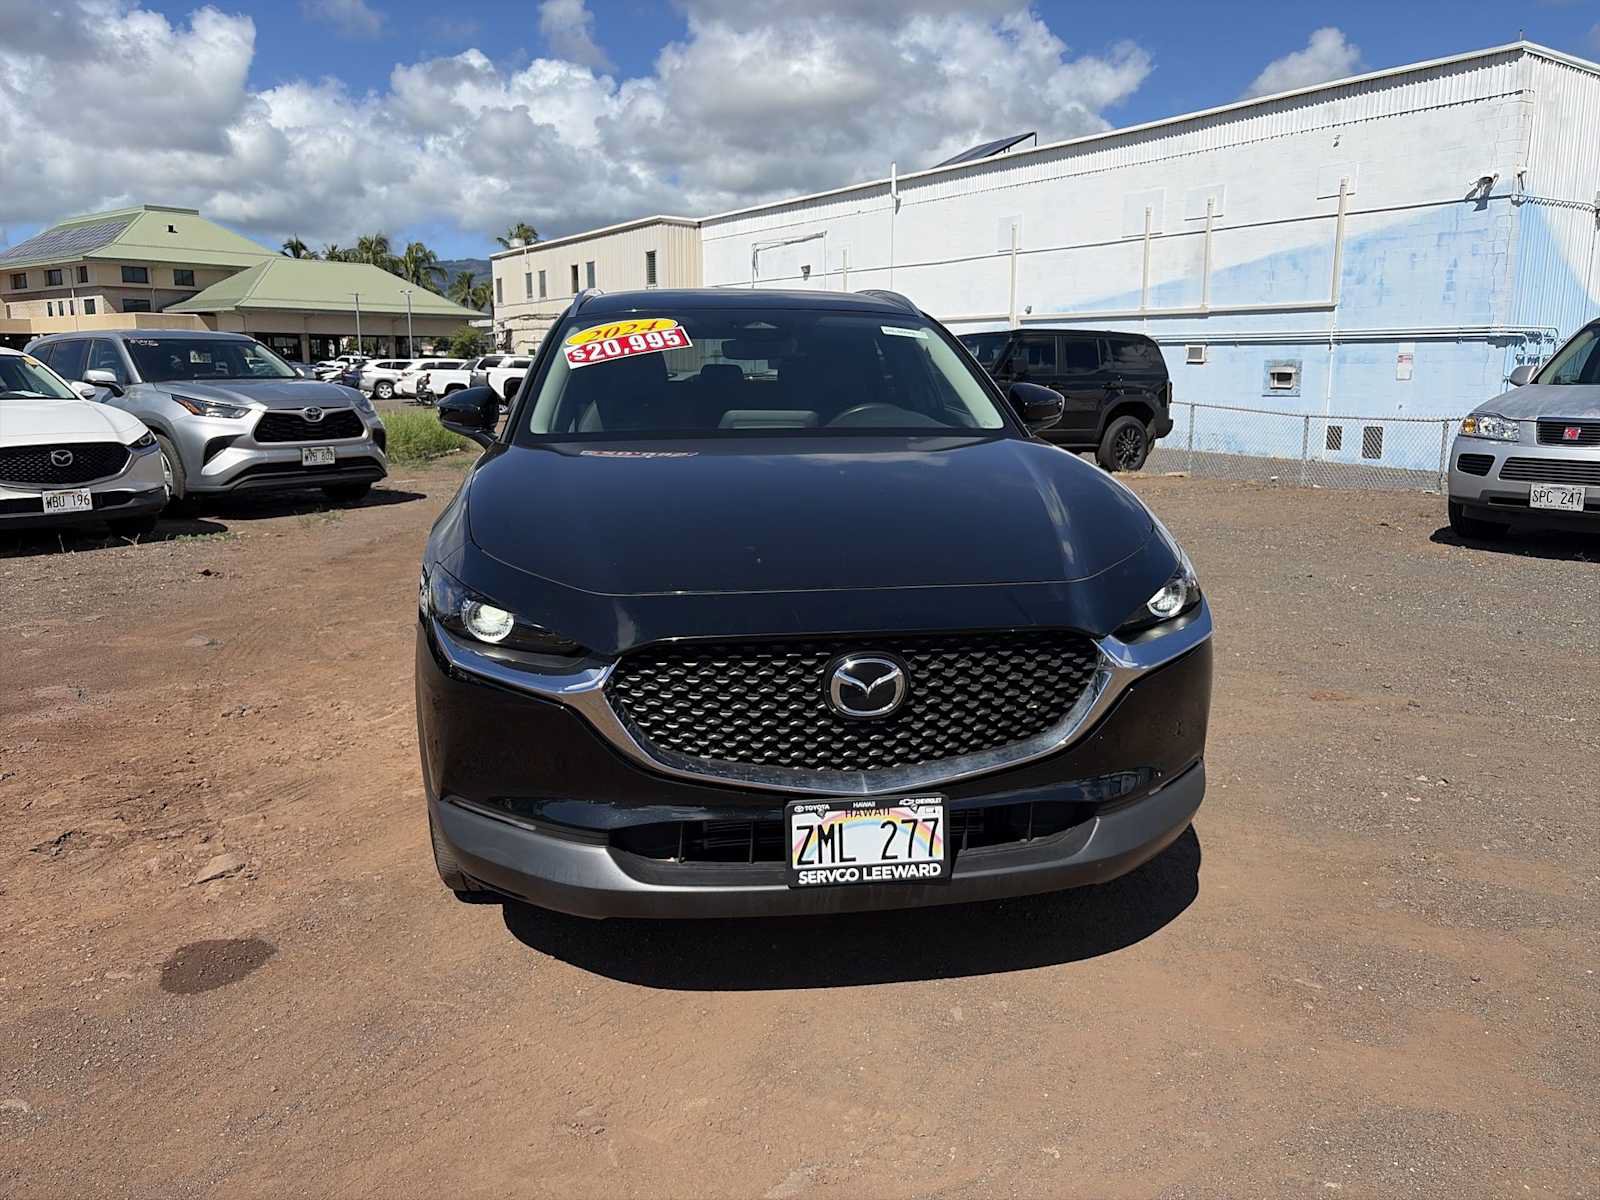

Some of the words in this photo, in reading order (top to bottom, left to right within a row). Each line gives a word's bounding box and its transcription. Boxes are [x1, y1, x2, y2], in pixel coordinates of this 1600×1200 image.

[586, 320, 658, 341] 2024
[571, 329, 681, 361] $20,995
[45, 495, 66, 509] WBU
[71, 493, 91, 507] 196
[1532, 489, 1553, 504] SPC
[1560, 491, 1582, 506] 247
[804, 804, 831, 812] TOYOTA
[852, 800, 876, 808] HAWAII
[845, 808, 890, 818] HAWAII
[796, 823, 857, 866] ZML
[879, 817, 940, 861] 277
[798, 867, 860, 885] SERVCO
[862, 863, 942, 881] LEEWARD
